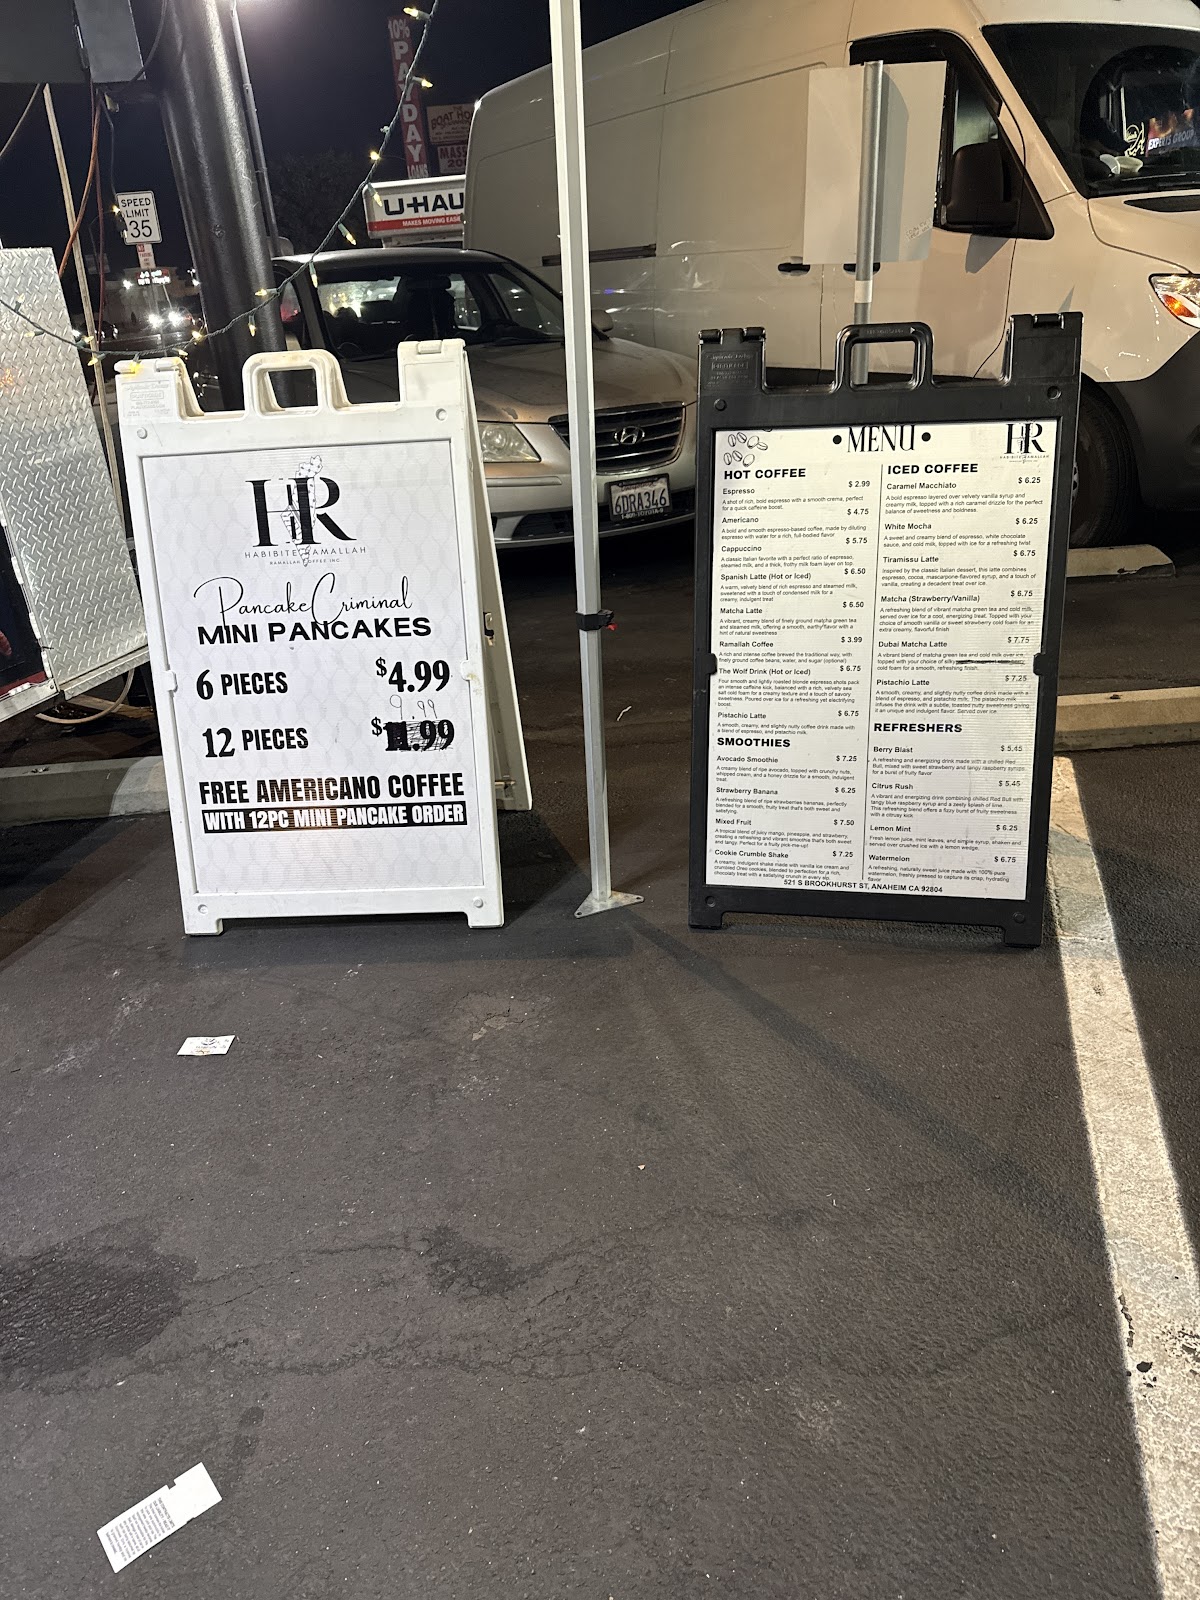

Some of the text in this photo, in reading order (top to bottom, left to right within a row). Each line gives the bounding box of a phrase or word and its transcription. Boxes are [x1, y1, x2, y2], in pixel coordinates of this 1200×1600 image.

[388, 18, 411, 39] 10%
[431, 112, 454, 131] BOAT
[440, 146, 467, 159] MASS
[407, 163, 429, 178] LOANS
[121, 198, 151, 207] SPEED
[383, 192, 464, 216] U-HAU
[126, 209, 149, 218] LIMIT
[402, 214, 461, 227] MAKES MOVING EASIE
[129, 220, 152, 238] 35
[847, 425, 915, 453] MENU
[887, 463, 979, 475] ICED COFFEE
[723, 468, 806, 480] HOT COFFEE
[848, 480, 871, 488] $ 2.99
[1018, 476, 1041, 484] $ 6.25
[886, 482, 917, 490] Caramel
[722, 487, 755, 496] Espresso
[615, 488, 667, 514] 6DRA346
[847, 508, 852, 516] $
[1015, 517, 1038, 525] $ 6.25
[907, 522, 932, 530] Mocha
[845, 537, 851, 545] $
[245, 550, 297, 558] HABIBITE
[721, 545, 762, 554] Cappuccino
[1013, 549, 1036, 557] $ 6.75
[844, 567, 866, 575] $ 6.50
[720, 573, 748, 582] Spanish
[794, 572, 812, 580] Iced)
[1010, 589, 1015, 598] $
[194, 572, 413, 629] Pancake Criminal
[880, 595, 980, 604] Matcha (Strawberry/Vanilla)
[842, 601, 847, 609] $
[198, 617, 432, 645] MINI PANCAKES
[929, 640, 948, 648] Latte
[1007, 636, 1030, 644] $ 7.75
[375, 656, 450, 692] $4.99
[718, 667, 732, 675] The
[793, 668, 811, 676] Iced)
[1005, 674, 1028, 683] $ 7.25
[196, 669, 288, 700] 6 PIECES
[717, 711, 749, 719] Pistachio
[873, 722, 963, 733] REFRESHERS
[202, 728, 309, 757] 12 PIECES
[717, 737, 791, 748] SMOOTHIES
[873, 746, 893, 754] Berry
[1000, 744, 1005, 752] $
[746, 756, 779, 764] Smoothie
[199, 773, 464, 804] FREE AMERICANO COFFEE
[871, 782, 893, 790] Citrus
[998, 780, 1003, 788] $
[716, 786, 752, 796] Strawberry
[834, 786, 839, 794] $
[204, 804, 464, 830] WITH 12PC MINI PANCAKE ORDER
[833, 818, 838, 826] $
[995, 824, 1018, 832] $ 6.25
[738, 850, 767, 858] Crumble
[768, 851, 789, 859] Shake
[868, 854, 910, 862] Watermelon
[994, 855, 999, 863] $
[783, 878, 796, 886] 521
[804, 880, 858, 889] BROOKHURST
[858, 882, 870, 890] ST,
[871, 883, 907, 891] ANAHEIM
[921, 885, 943, 893] 92804
